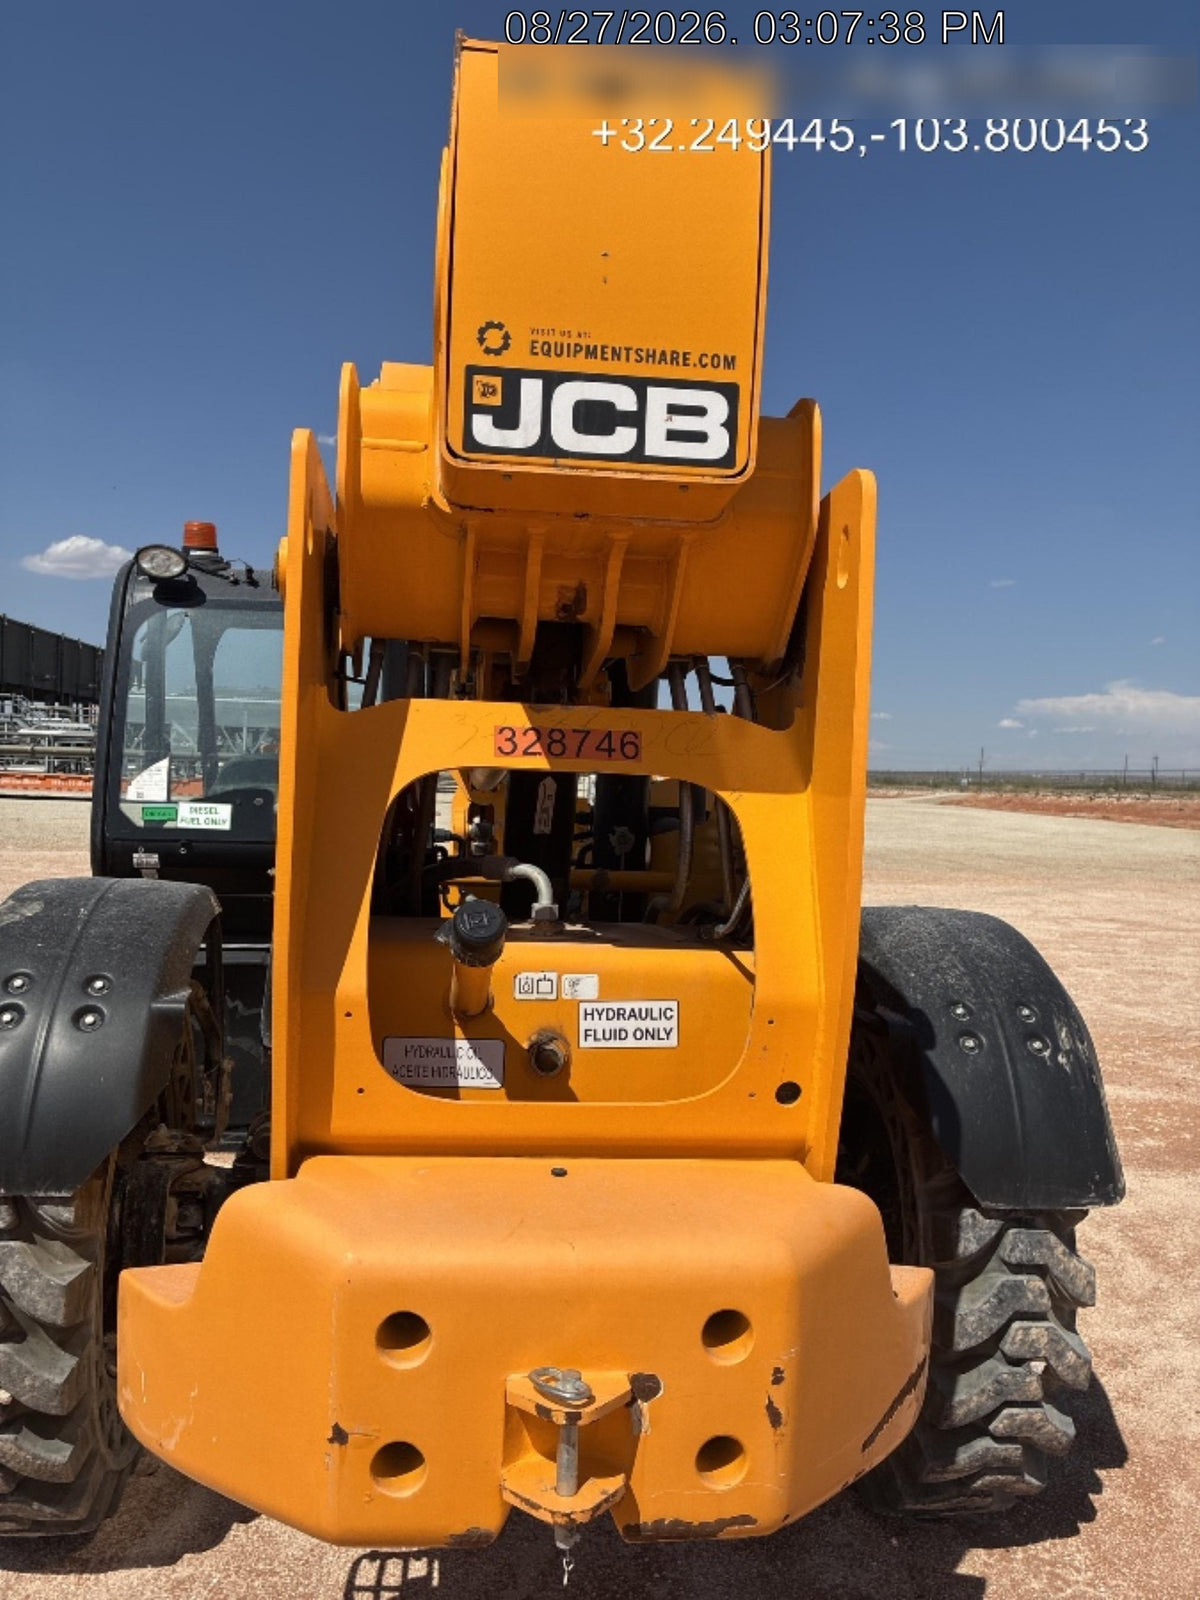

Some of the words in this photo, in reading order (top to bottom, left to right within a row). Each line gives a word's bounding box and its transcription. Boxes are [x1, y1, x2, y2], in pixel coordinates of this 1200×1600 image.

[529, 340, 737, 370] EQUIPMENTSHARE.COM
[471, 378, 730, 460] JCB
[497, 727, 640, 760] 328746
[189, 807, 219, 815] DIESEL
[584, 1007, 674, 1022] HYDRAULIC
[584, 1028, 628, 1042] FLUID
[633, 1027, 673, 1042] ONLY
